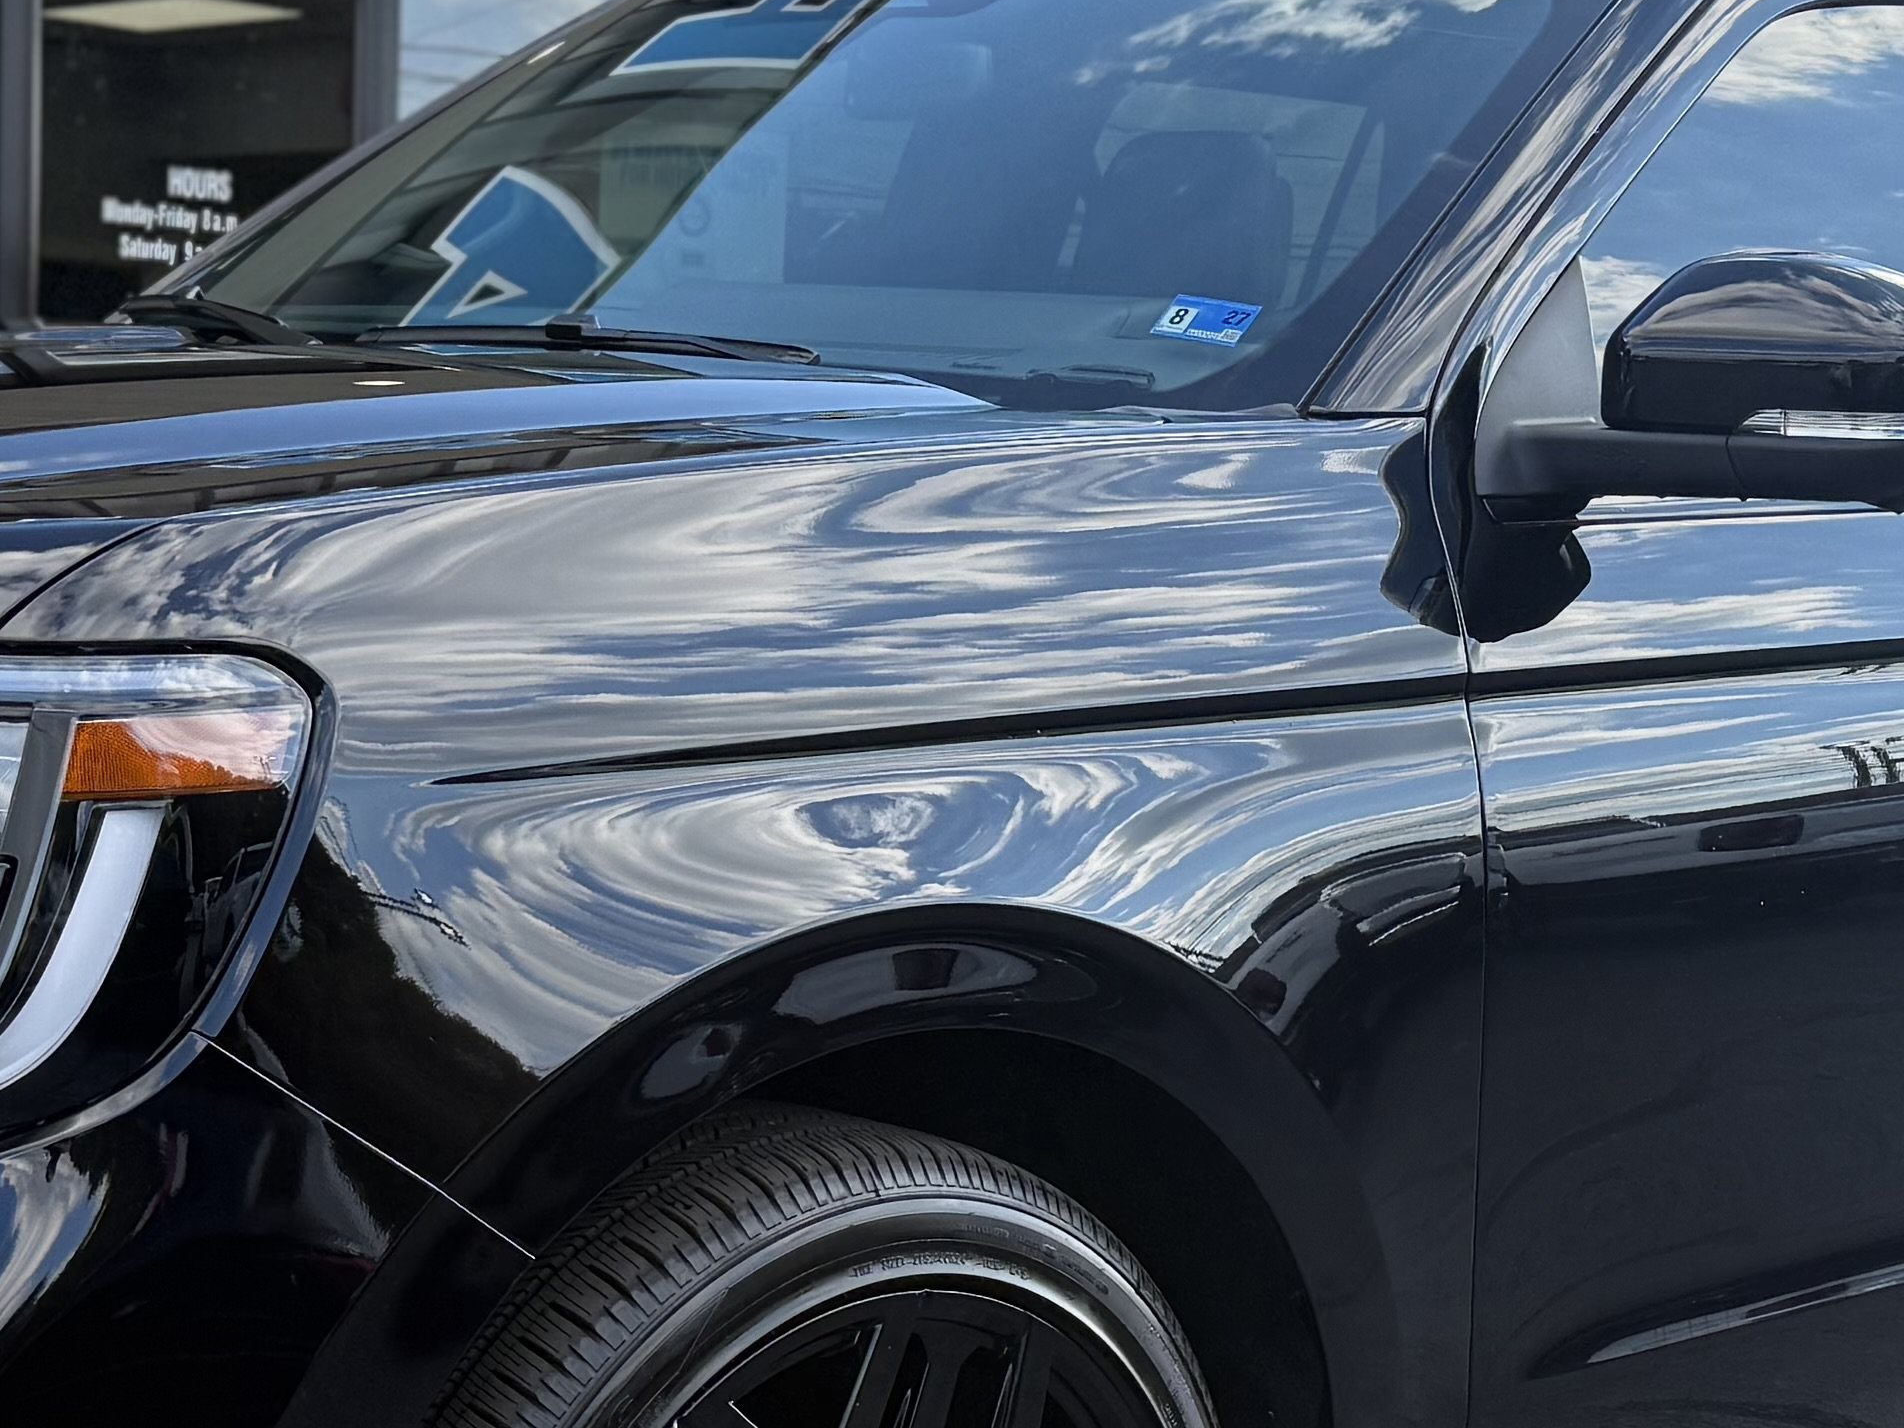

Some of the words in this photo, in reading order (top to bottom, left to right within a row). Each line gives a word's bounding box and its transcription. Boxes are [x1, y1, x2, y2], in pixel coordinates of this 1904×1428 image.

[167, 165, 234, 203] HOURS
[101, 196, 198, 234] Monday-Friday
[118, 232, 177, 266] Saturday
[1168, 308, 1190, 325] 8
[1221, 310, 1252, 326] 27
